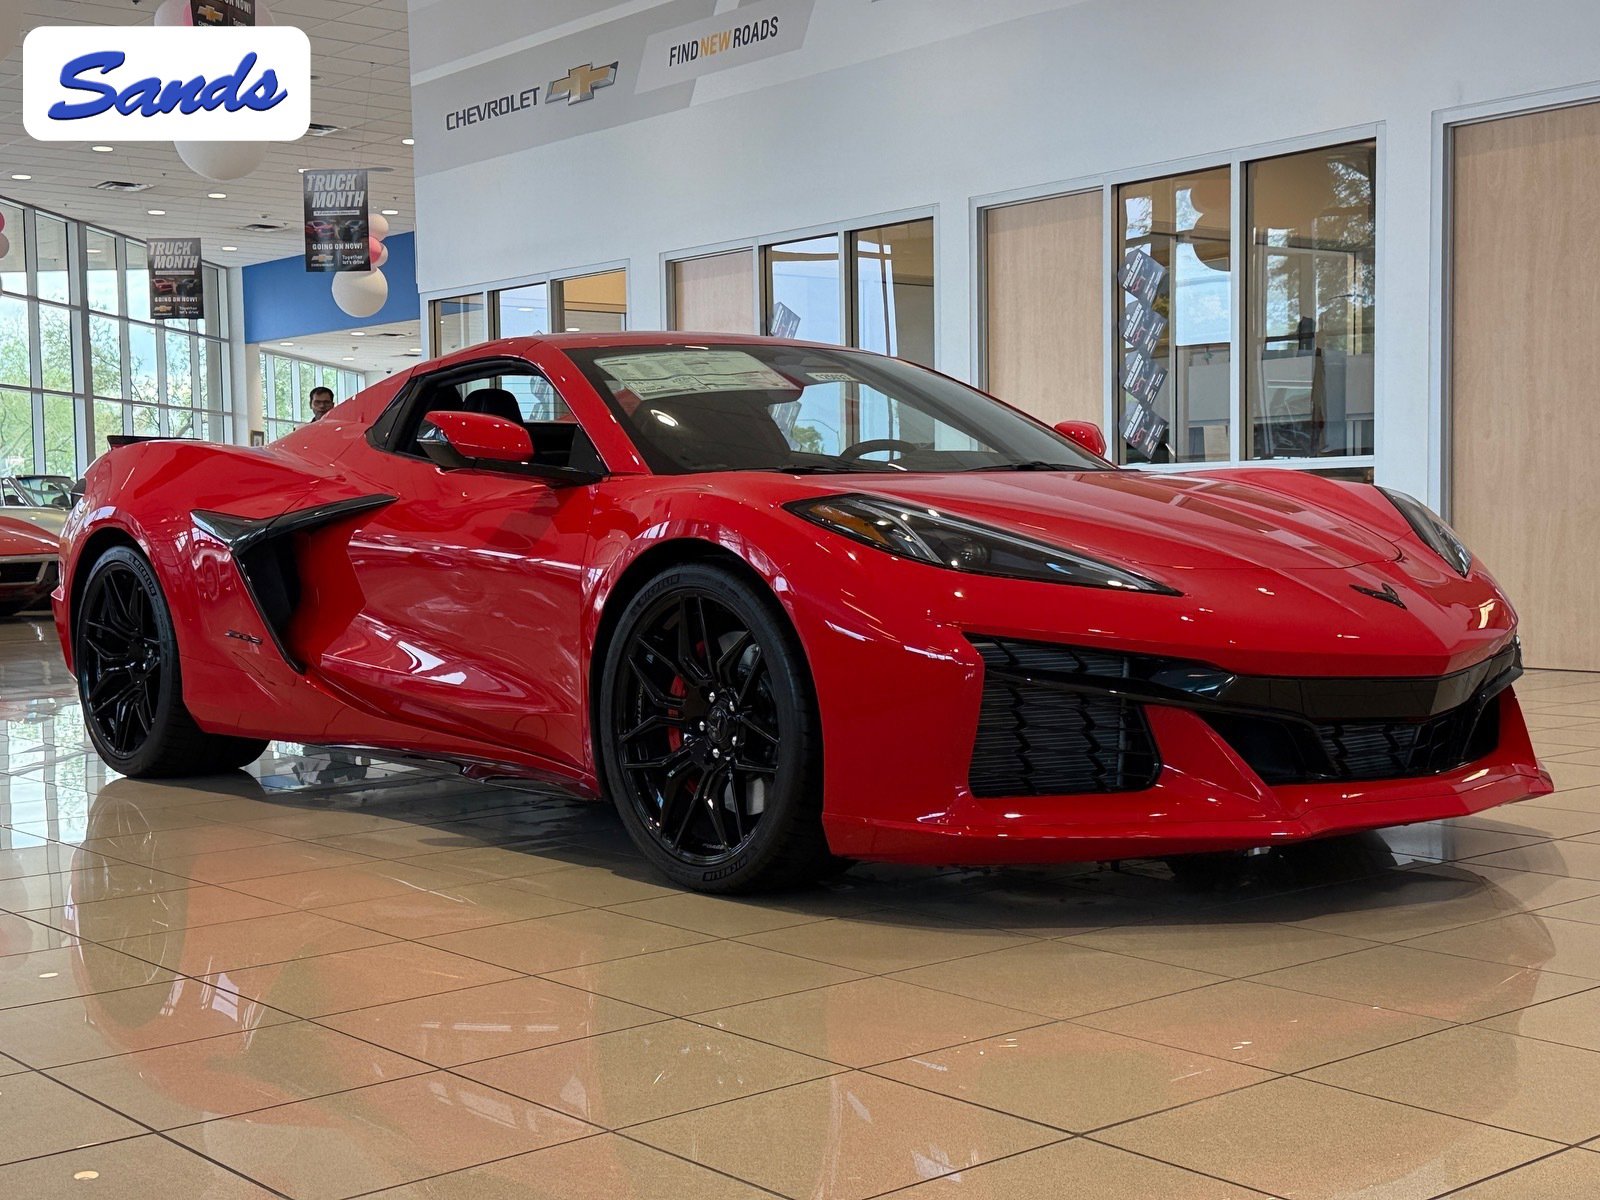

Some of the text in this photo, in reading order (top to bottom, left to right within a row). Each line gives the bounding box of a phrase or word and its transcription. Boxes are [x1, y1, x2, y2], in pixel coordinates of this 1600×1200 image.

[669, 16, 779, 67] FIND NEW ROADS
[446, 87, 540, 130] CHEVROLET
[307, 173, 357, 191] TRUCK
[312, 191, 365, 208] MONTH
[150, 242, 192, 255] TRUCK
[154, 255, 199, 269] MONTH
[133, 556, 157, 597] MICHELIN
